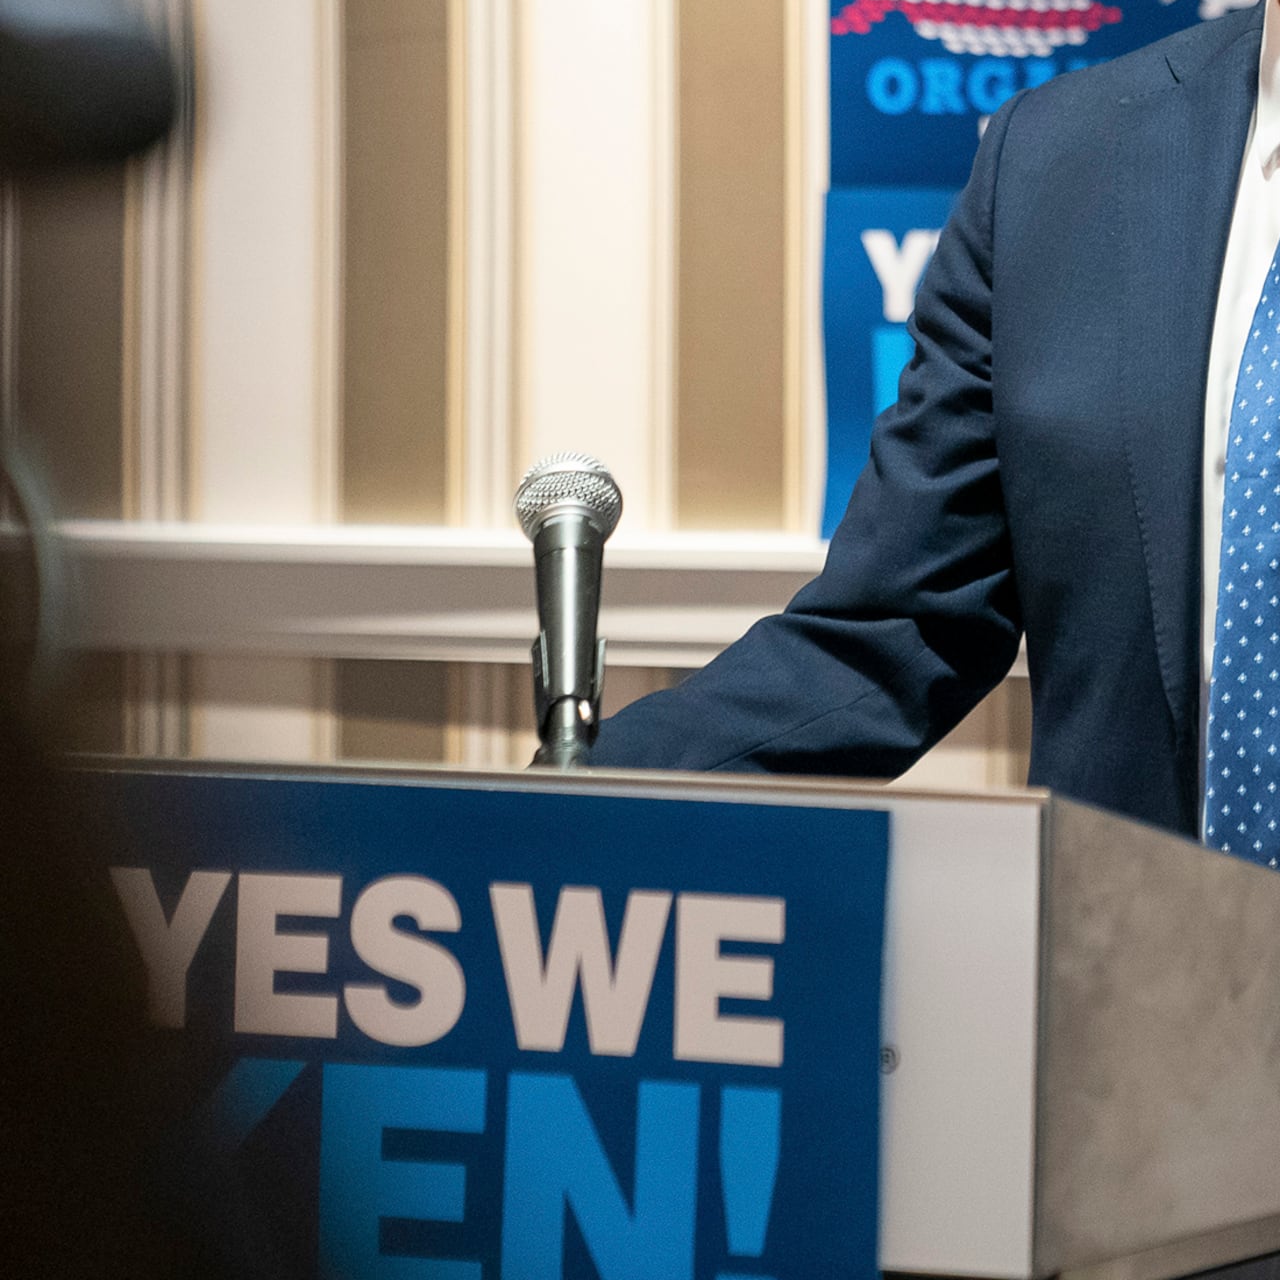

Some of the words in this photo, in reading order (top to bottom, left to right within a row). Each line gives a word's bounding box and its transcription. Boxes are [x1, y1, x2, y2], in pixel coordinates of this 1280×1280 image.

[110, 867, 466, 1048] YES
[489, 881, 786, 1067] WE
[215, 1057, 781, 1280] EN!
